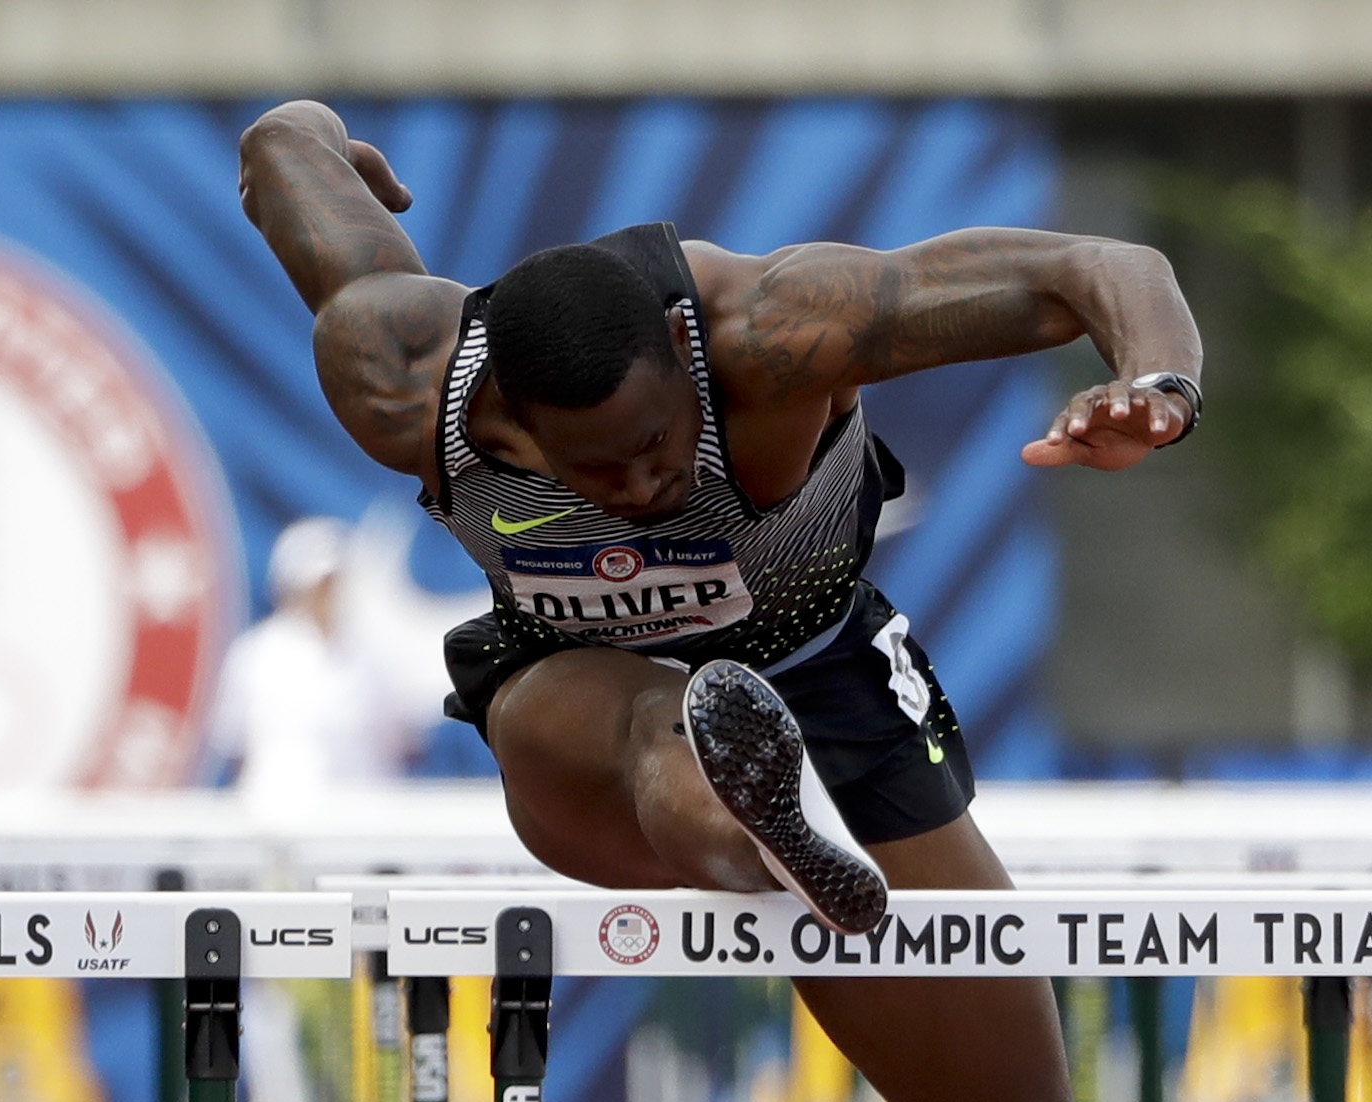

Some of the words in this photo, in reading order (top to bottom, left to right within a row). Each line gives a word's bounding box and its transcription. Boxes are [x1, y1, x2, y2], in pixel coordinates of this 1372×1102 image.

[676, 551, 716, 561] USATF
[532, 580, 731, 622] OLIVER
[250, 928, 337, 947] UCS
[403, 926, 491, 945] UCS
[680, 911, 775, 964] U.S.
[790, 913, 1026, 966] OLYMPIC
[1057, 912, 1219, 965] TEAM
[77, 957, 131, 971] USATF
